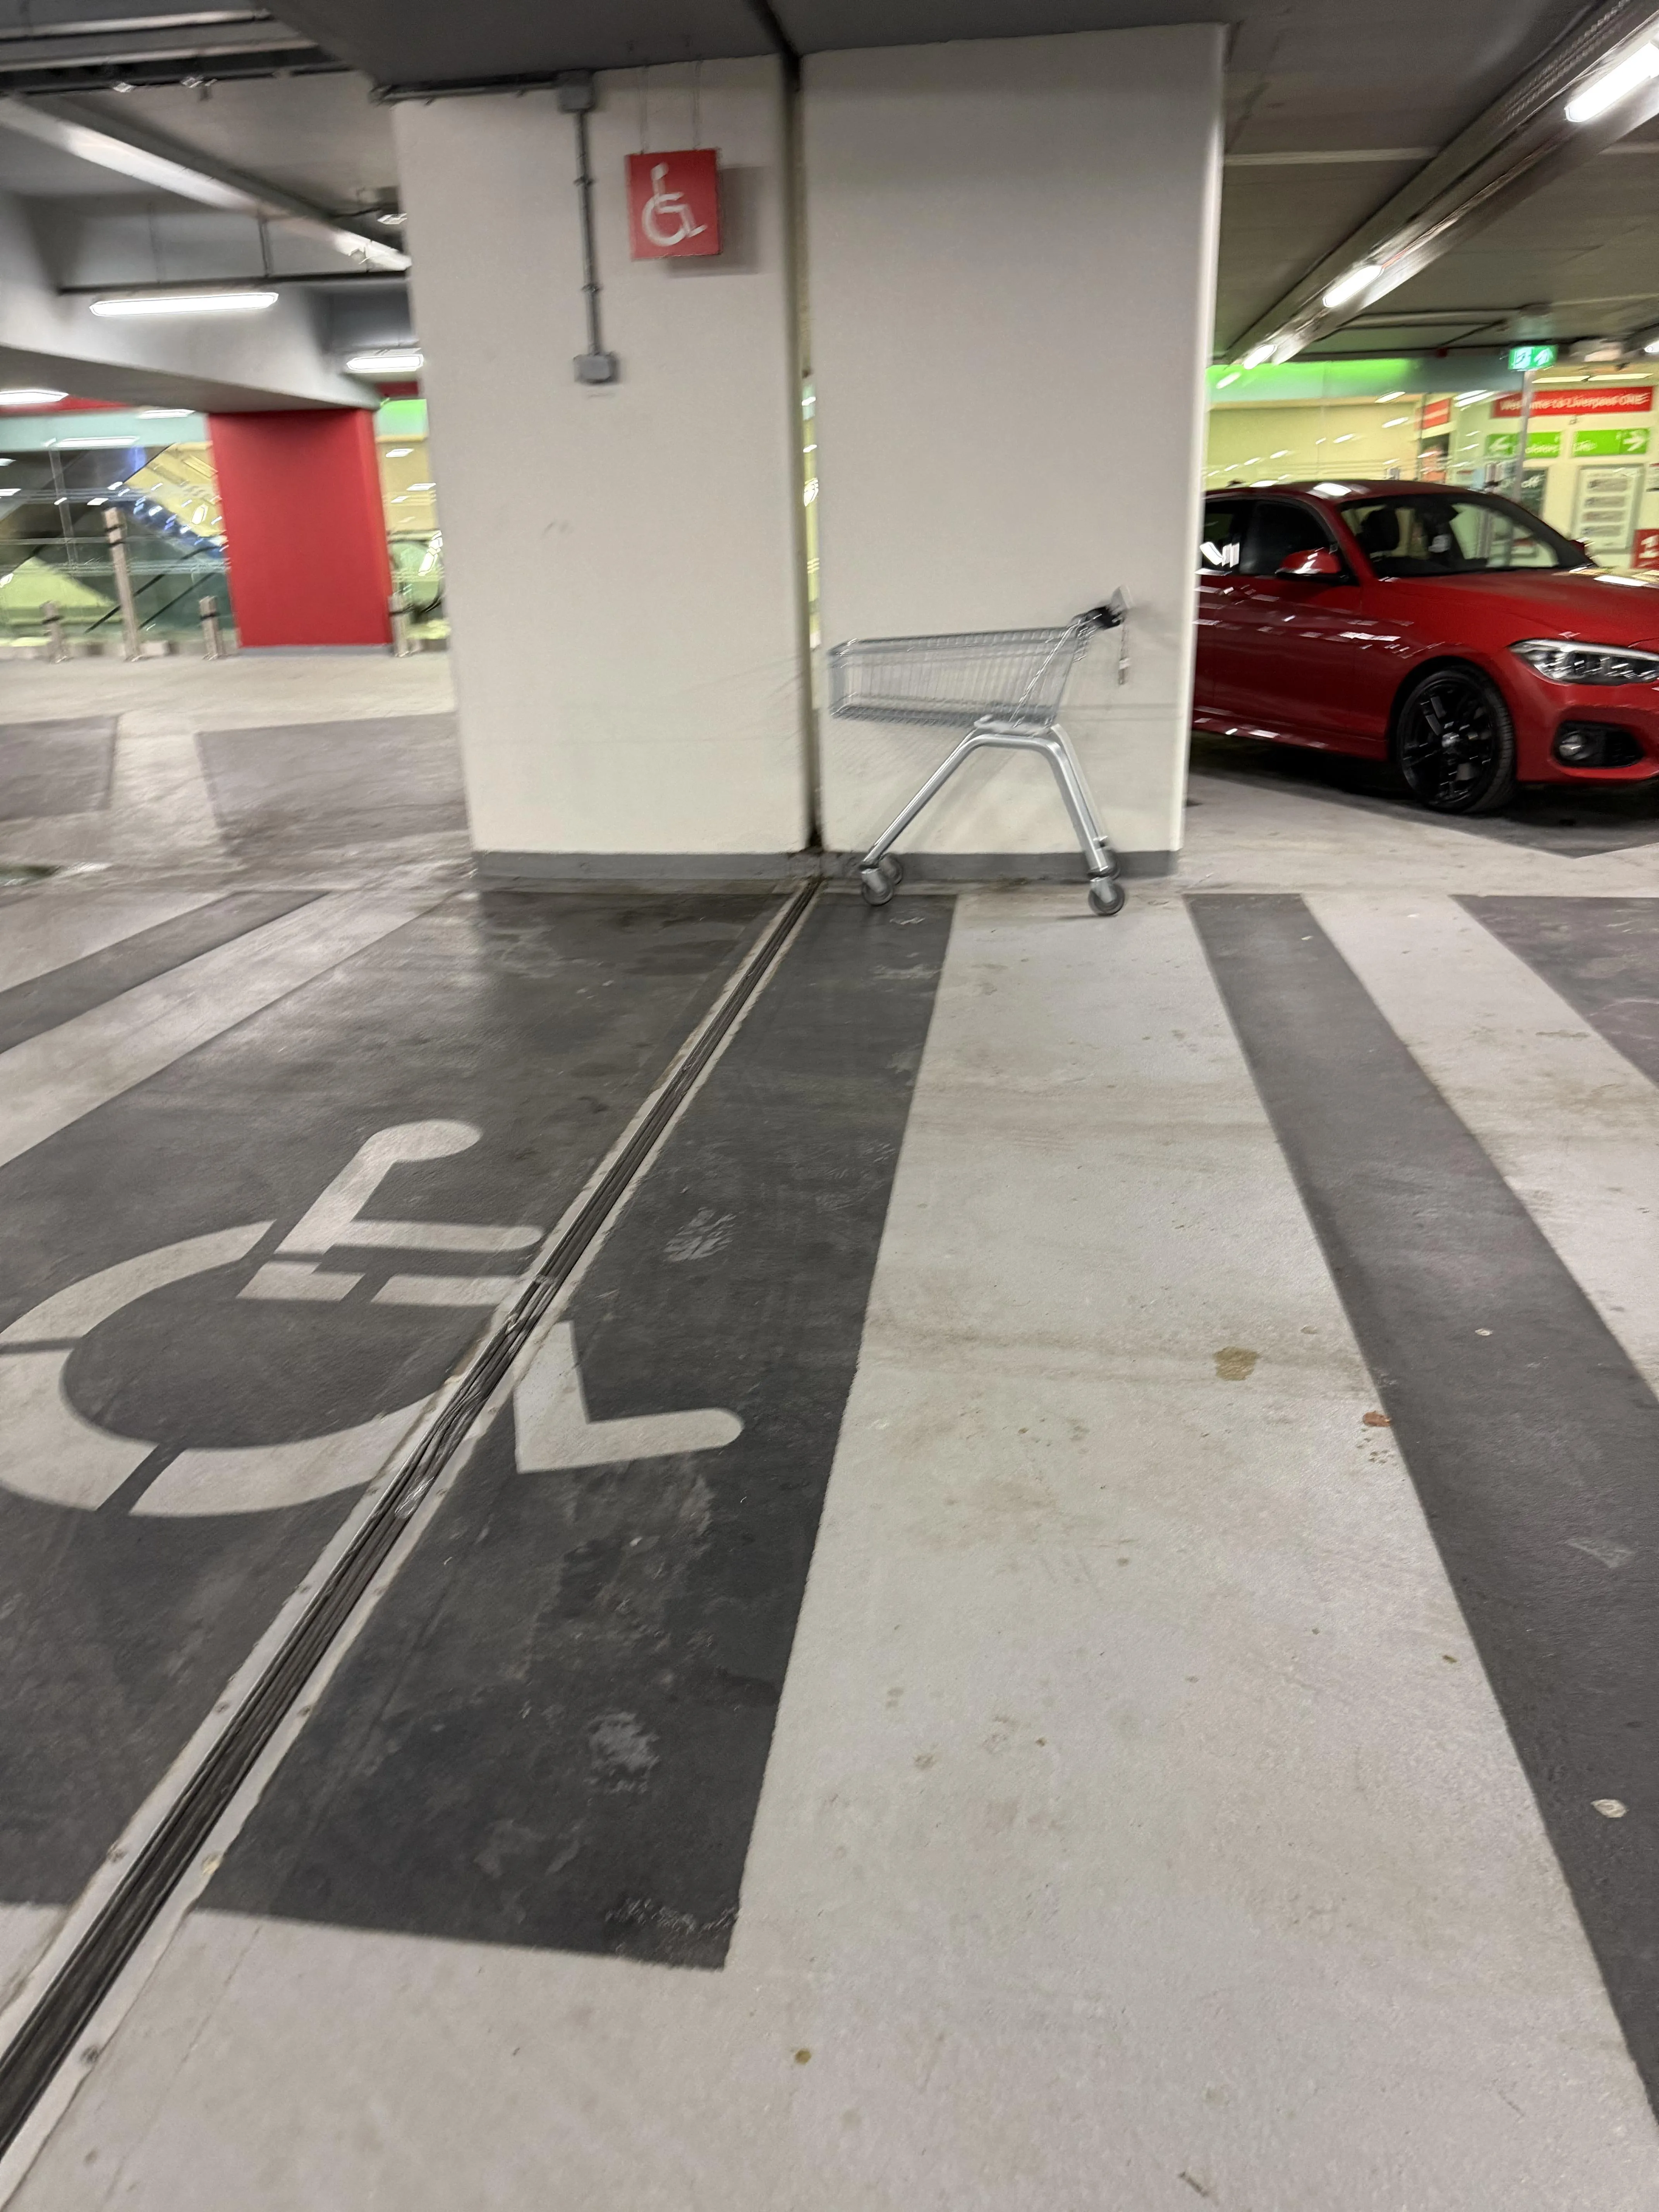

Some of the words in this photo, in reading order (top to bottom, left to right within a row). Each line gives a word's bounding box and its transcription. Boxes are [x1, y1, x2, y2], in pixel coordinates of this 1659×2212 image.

[1500, 399, 1552, 411] Welme
[1567, 395, 1621, 409] Liverpool
[1619, 393, 1650, 405] ONE
